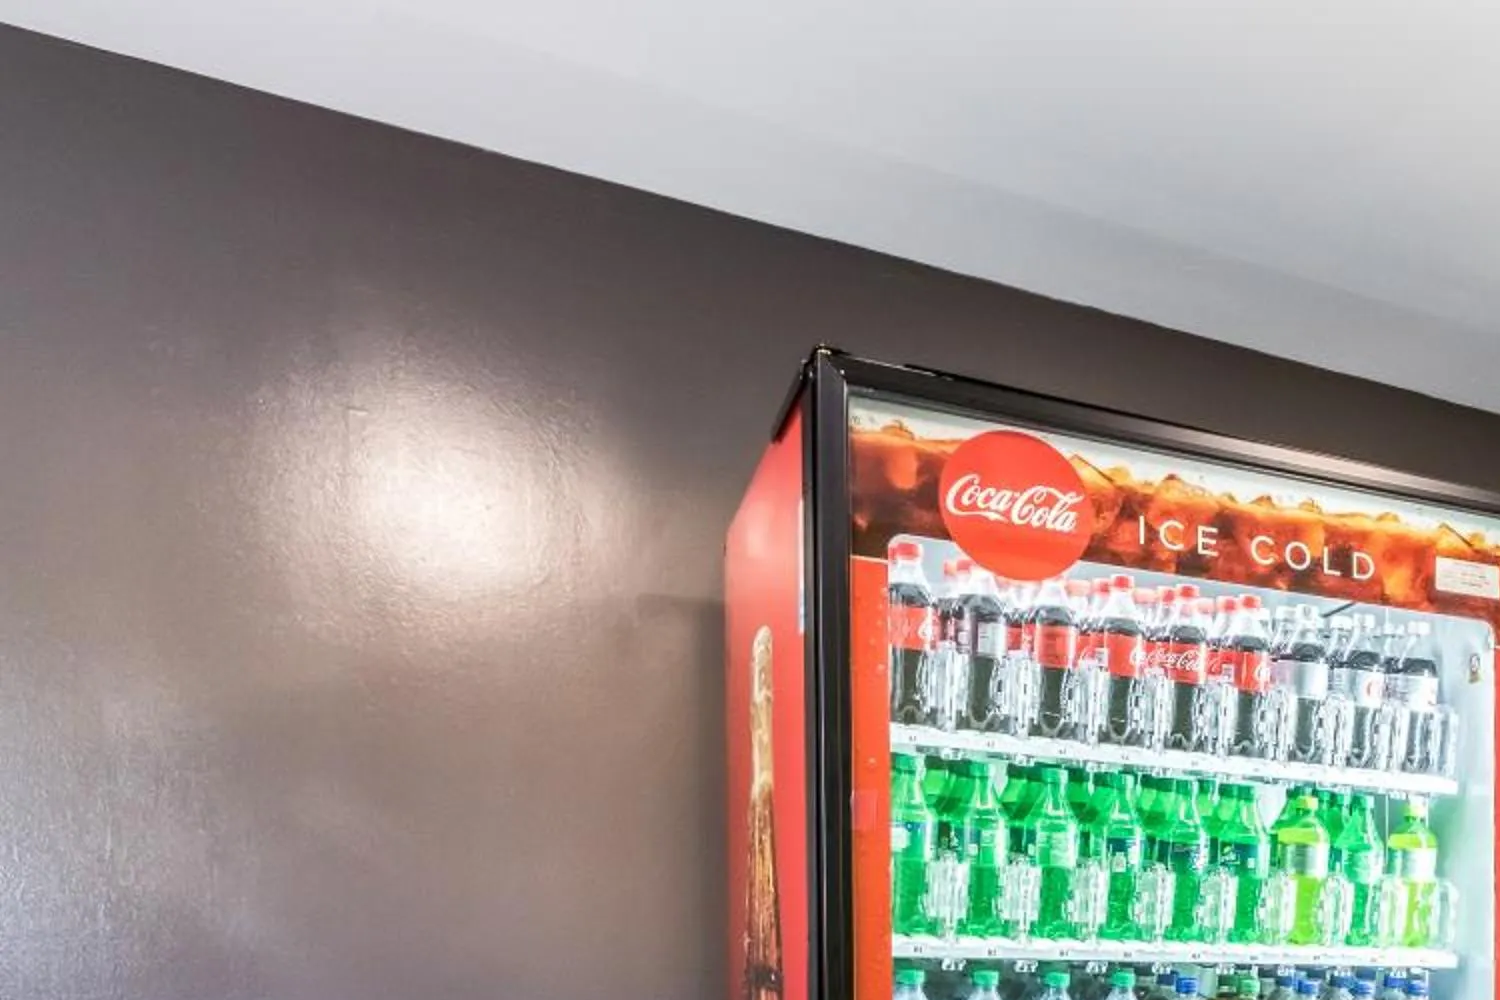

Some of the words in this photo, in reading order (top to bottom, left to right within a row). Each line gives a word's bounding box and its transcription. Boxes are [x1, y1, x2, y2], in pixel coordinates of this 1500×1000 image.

[945, 472, 1086, 535] Coca-Cola
[1138, 515, 1220, 559] ICE
[1250, 535, 1377, 581] COLD
